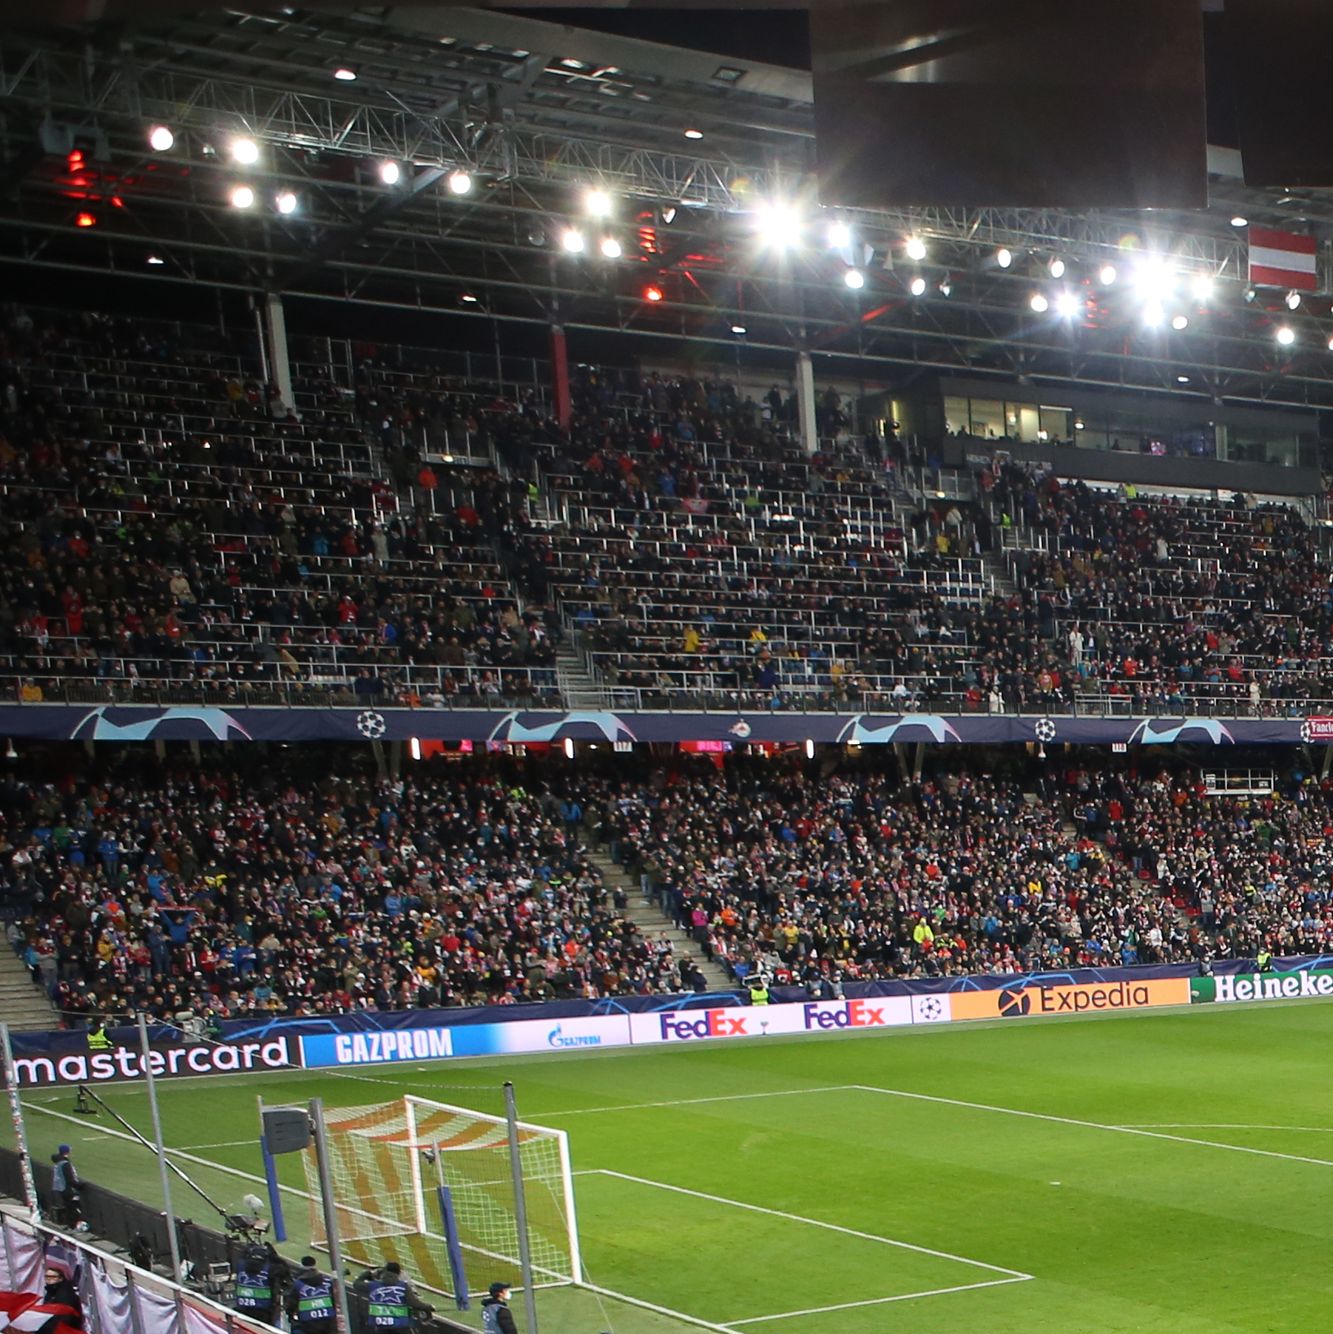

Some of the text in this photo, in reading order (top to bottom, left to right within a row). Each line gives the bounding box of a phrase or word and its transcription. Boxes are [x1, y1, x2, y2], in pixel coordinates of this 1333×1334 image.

[1040, 981, 1150, 1013] Expedia
[660, 1008, 749, 1041] FedEx
[804, 998, 886, 1031] FedEx
[14, 1035, 288, 1084] mastercard
[336, 1028, 454, 1064] GAZPROM
